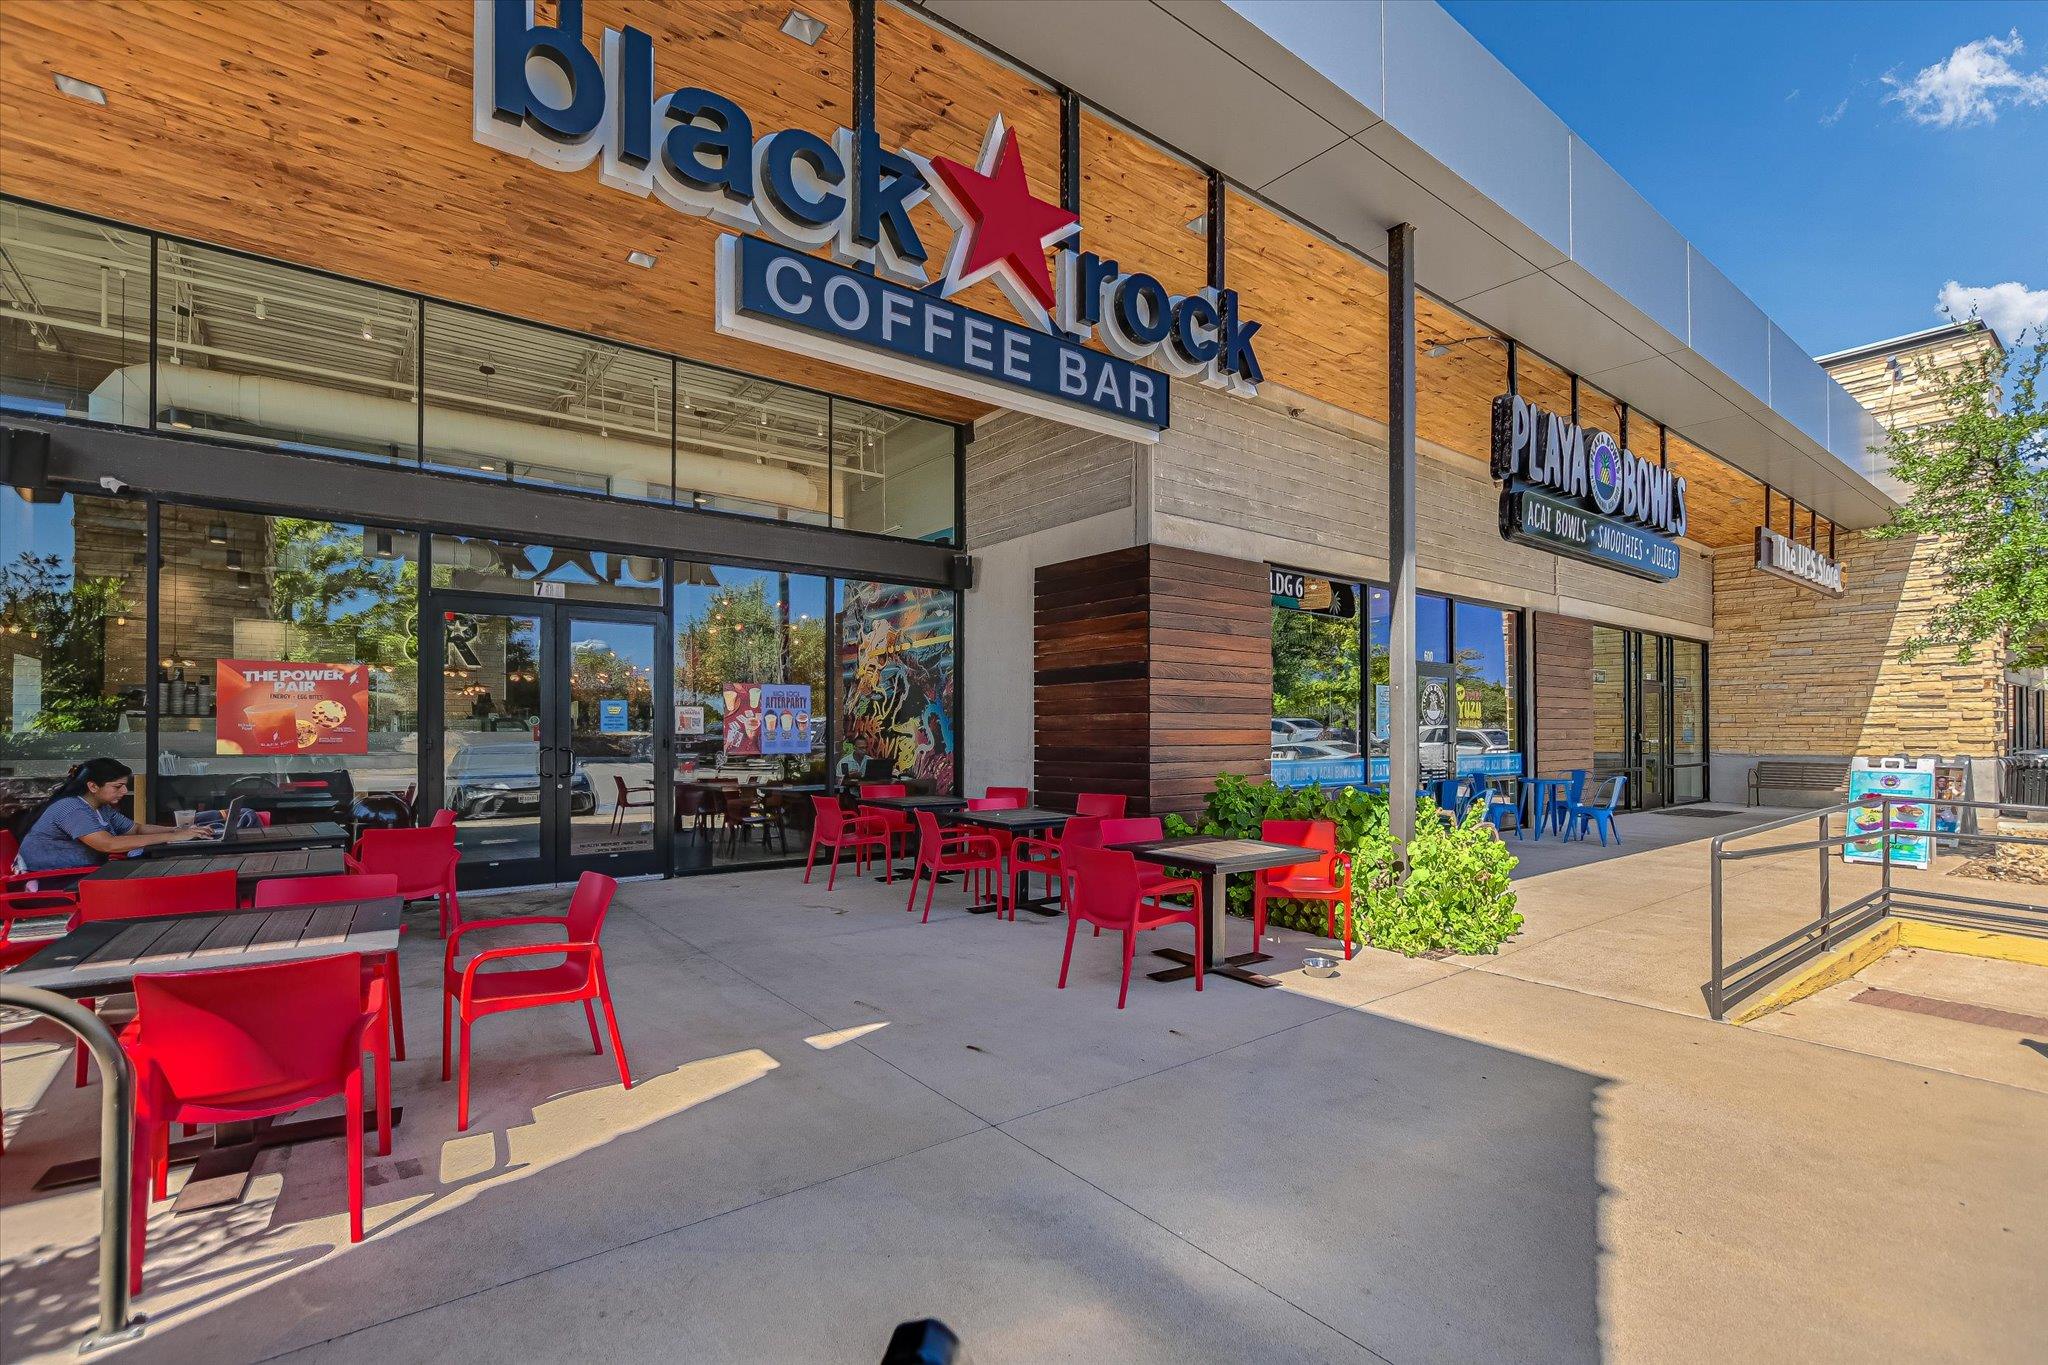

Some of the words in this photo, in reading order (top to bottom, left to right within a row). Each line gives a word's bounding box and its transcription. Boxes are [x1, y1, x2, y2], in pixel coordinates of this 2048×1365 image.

[490, 0, 930, 272] black
[1075, 250, 1265, 386] rock
[765, 256, 1032, 382] COFFEE
[1059, 347, 1156, 419] BAR
[1511, 394, 1588, 498] PLAYA
[1623, 448, 1687, 537] BOWLS
[1527, 501, 1552, 533] ACAI
[1555, 509, 1587, 544] BOWLS
[1597, 525, 1643, 561] SMOOTHIES
[1651, 544, 1677, 572] JUICES
[1774, 535, 1796, 572] The
[1797, 544, 1816, 579] UPS
[1817, 554, 1840, 587] Store
[1270, 572, 1293, 597] LDG
[1295, 577, 1304, 598] 6
[243, 670, 278, 682] THE
[279, 669, 344, 681] POWER
[273, 681, 317, 693] PAIR
[765, 696, 808, 709] AFTERPARTY
[1457, 701, 1482, 719] YUZU
[1293, 766, 1311, 781] JUICE
[1319, 765, 1334, 780] ACAI
[1335, 764, 1356, 779] BOWLS
